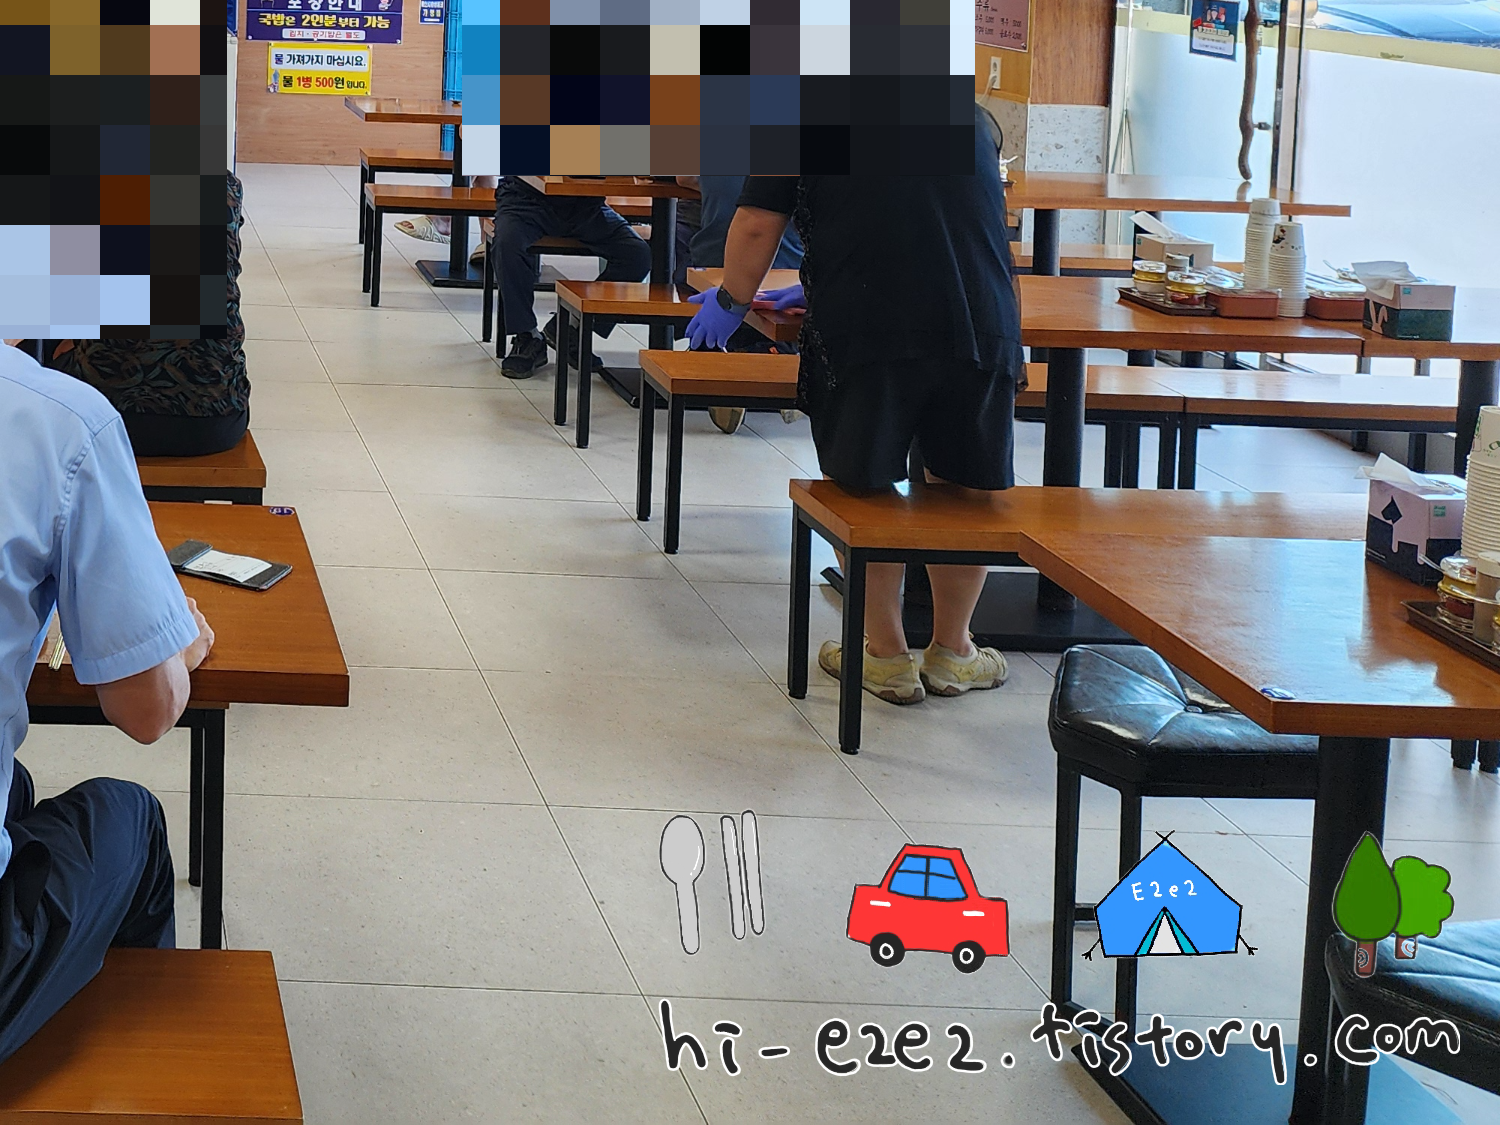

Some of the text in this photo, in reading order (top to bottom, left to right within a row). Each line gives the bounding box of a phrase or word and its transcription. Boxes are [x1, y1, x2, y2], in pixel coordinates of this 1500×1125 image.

[258, 12, 296, 26] 국밥은
[363, 15, 390, 29] 가능
[274, 53, 366, 67] 물 가져가지 마십시요.
[282, 75, 368, 90] 물 1병 500원 입니다.
